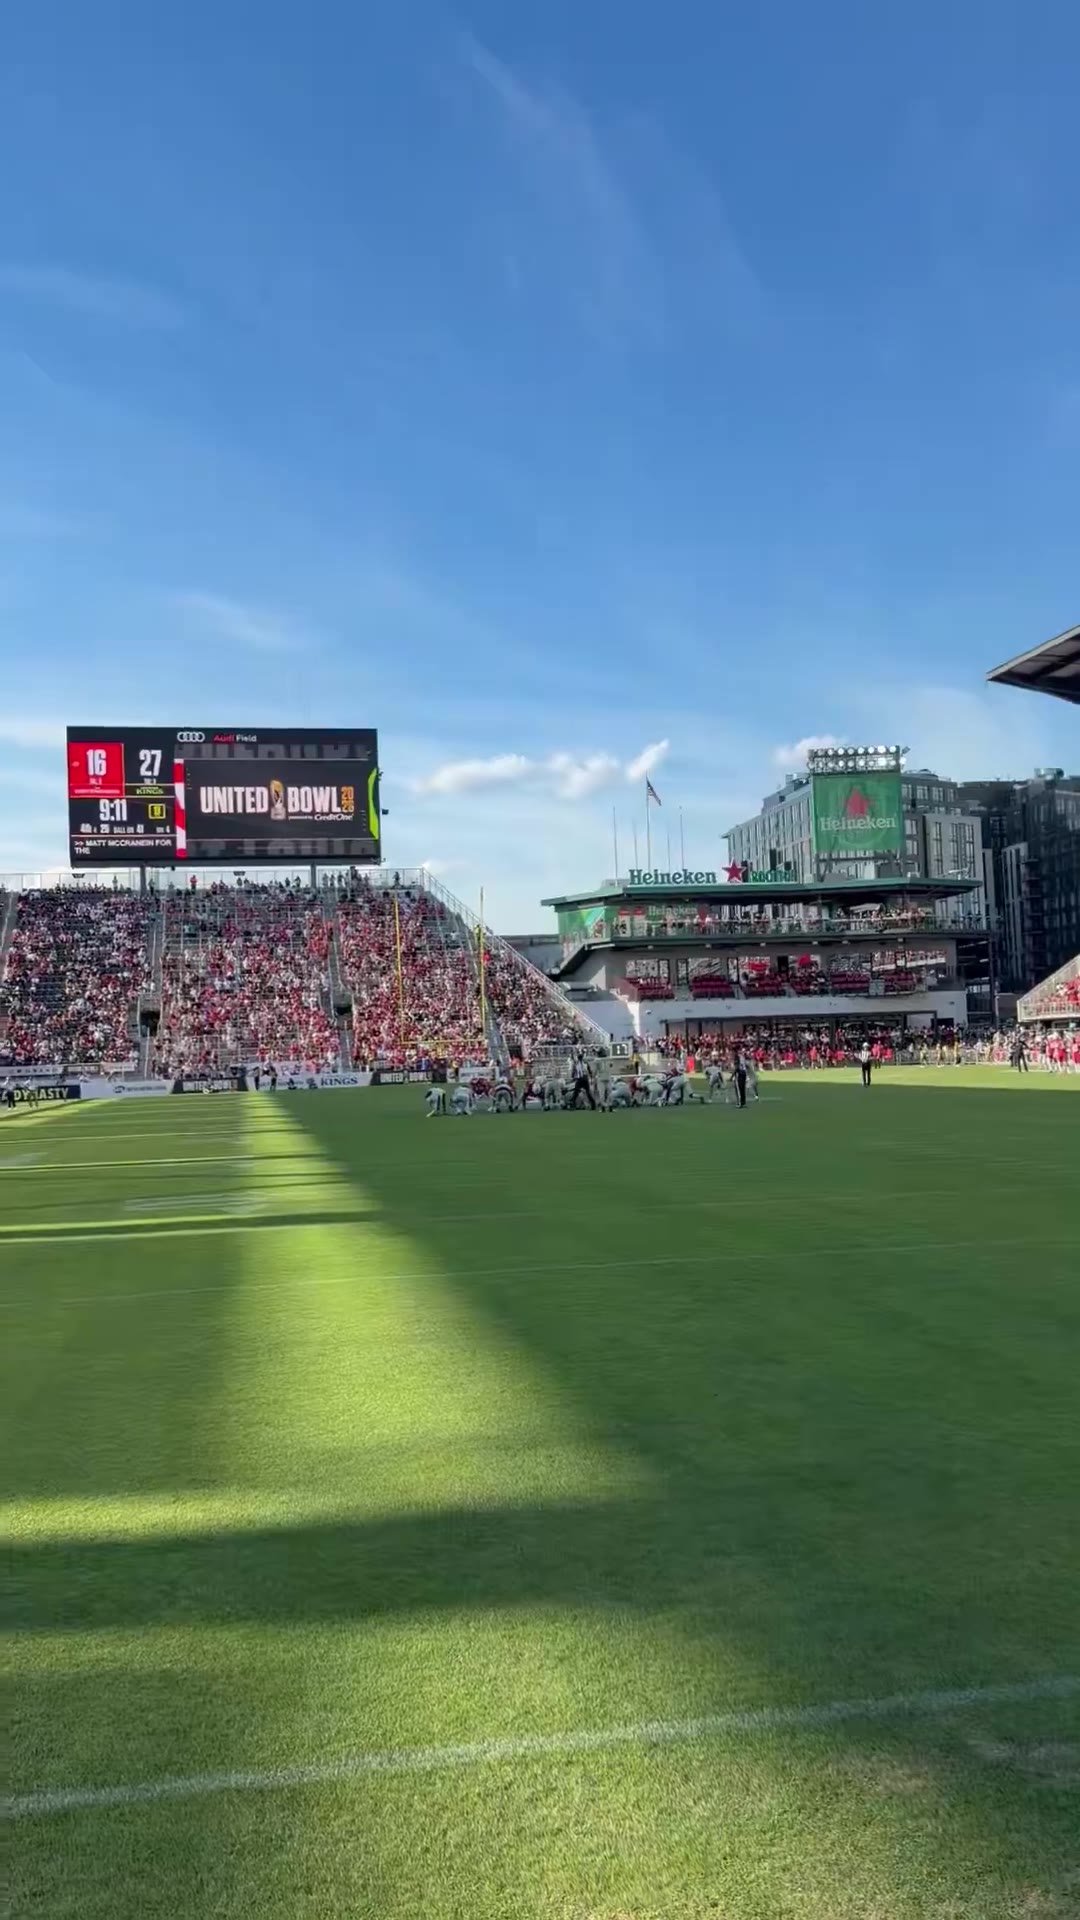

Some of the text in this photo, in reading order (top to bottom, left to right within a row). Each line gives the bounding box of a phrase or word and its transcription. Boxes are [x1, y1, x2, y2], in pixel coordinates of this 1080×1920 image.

[213, 734, 257, 742] Audi Field
[86, 749, 107, 776] 16
[139, 749, 162, 777] 27
[200, 786, 342, 813] UNITED BOWL
[99, 799, 127, 821] 9:11
[820, 815, 896, 831] Heineken
[629, 869, 717, 884] Heineken
[321, 1077, 359, 1086] KINGS
